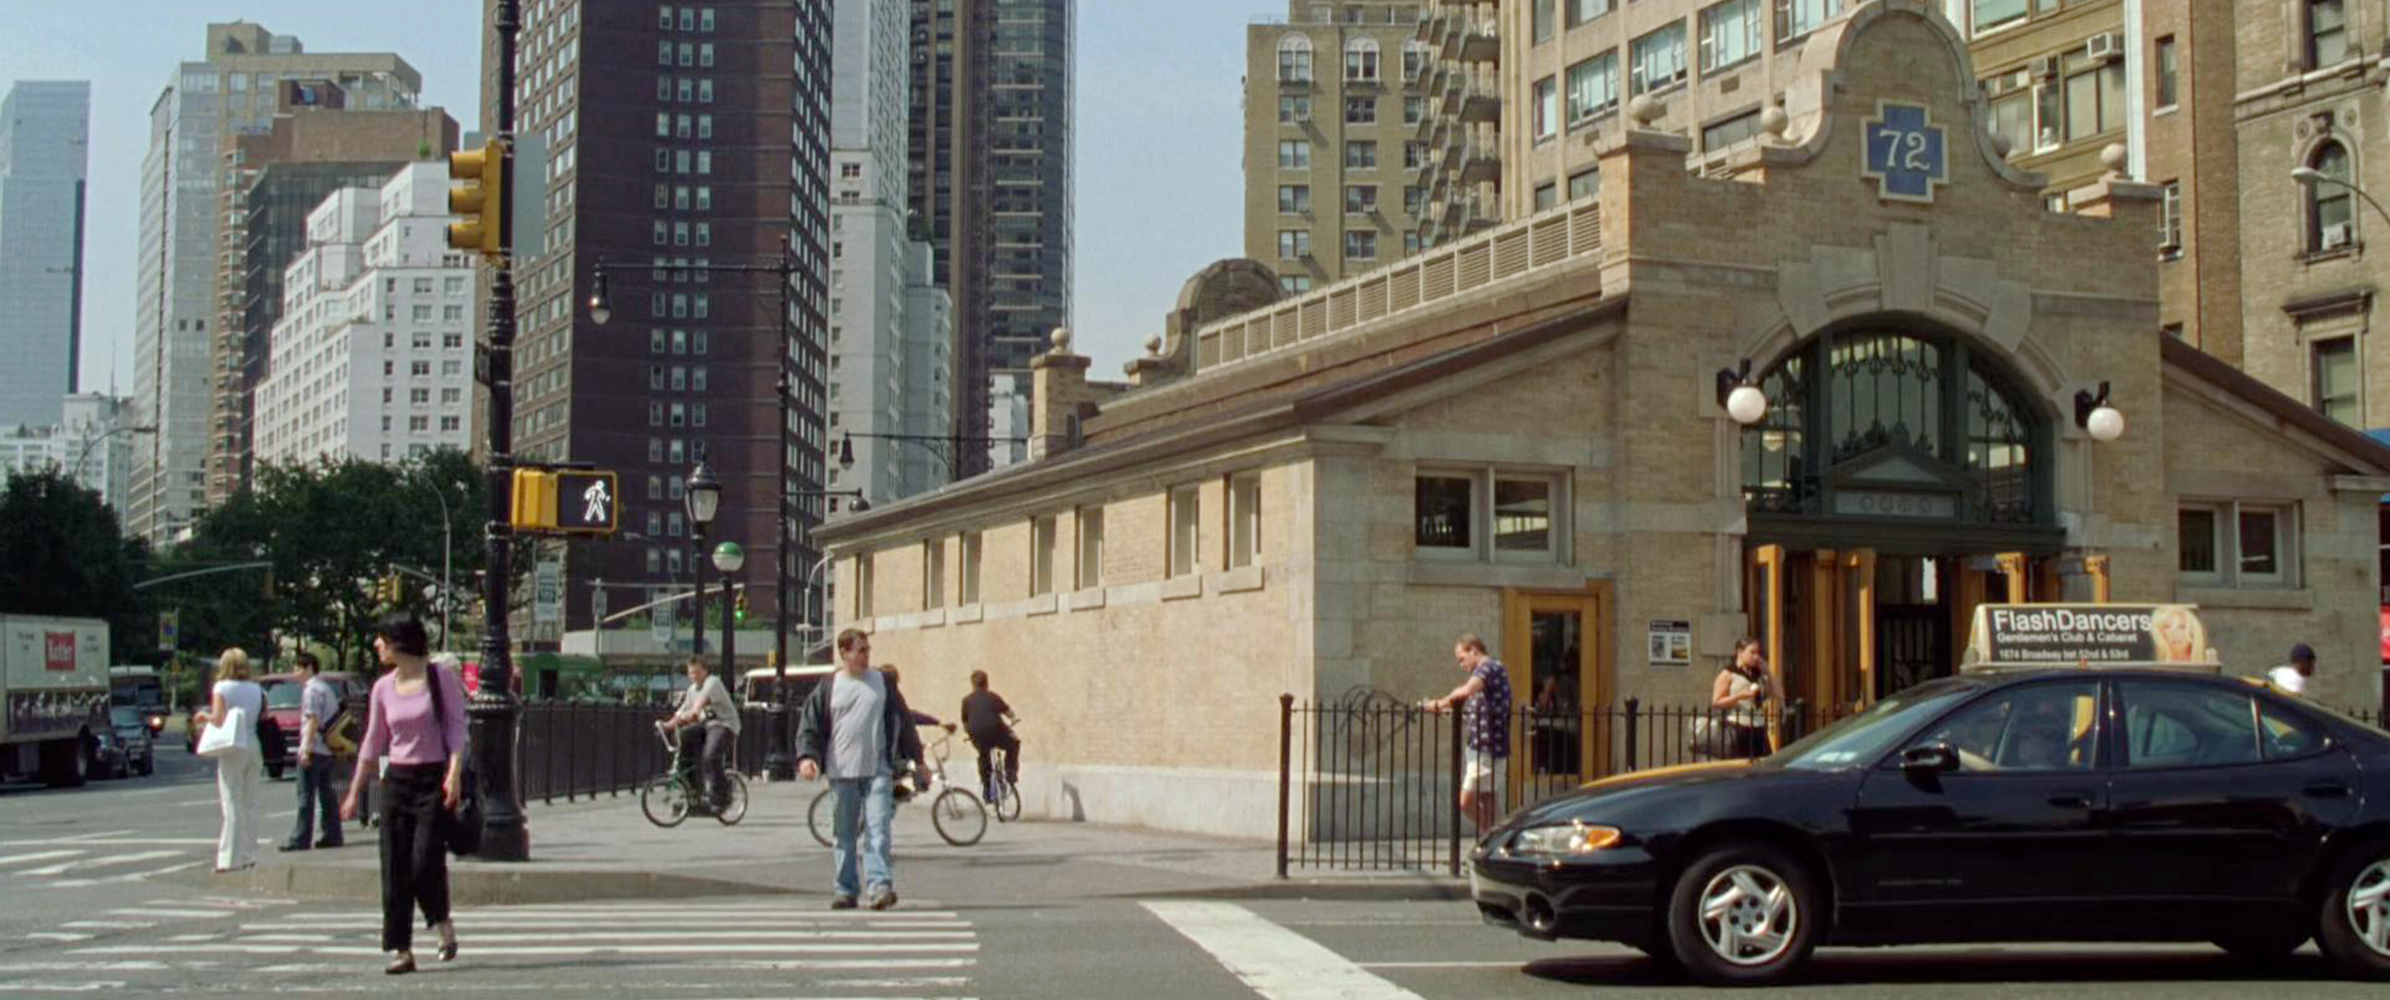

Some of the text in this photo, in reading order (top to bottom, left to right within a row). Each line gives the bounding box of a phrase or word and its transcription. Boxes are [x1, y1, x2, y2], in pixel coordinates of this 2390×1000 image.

[1879, 130, 1931, 170] 72
[1993, 609, 2152, 632] FlashDancers
[1996, 632, 2138, 643] Gentlemen's Club & Cabaret
[2021, 649, 2062, 661] Broadway
[2102, 649, 2108, 660] &
